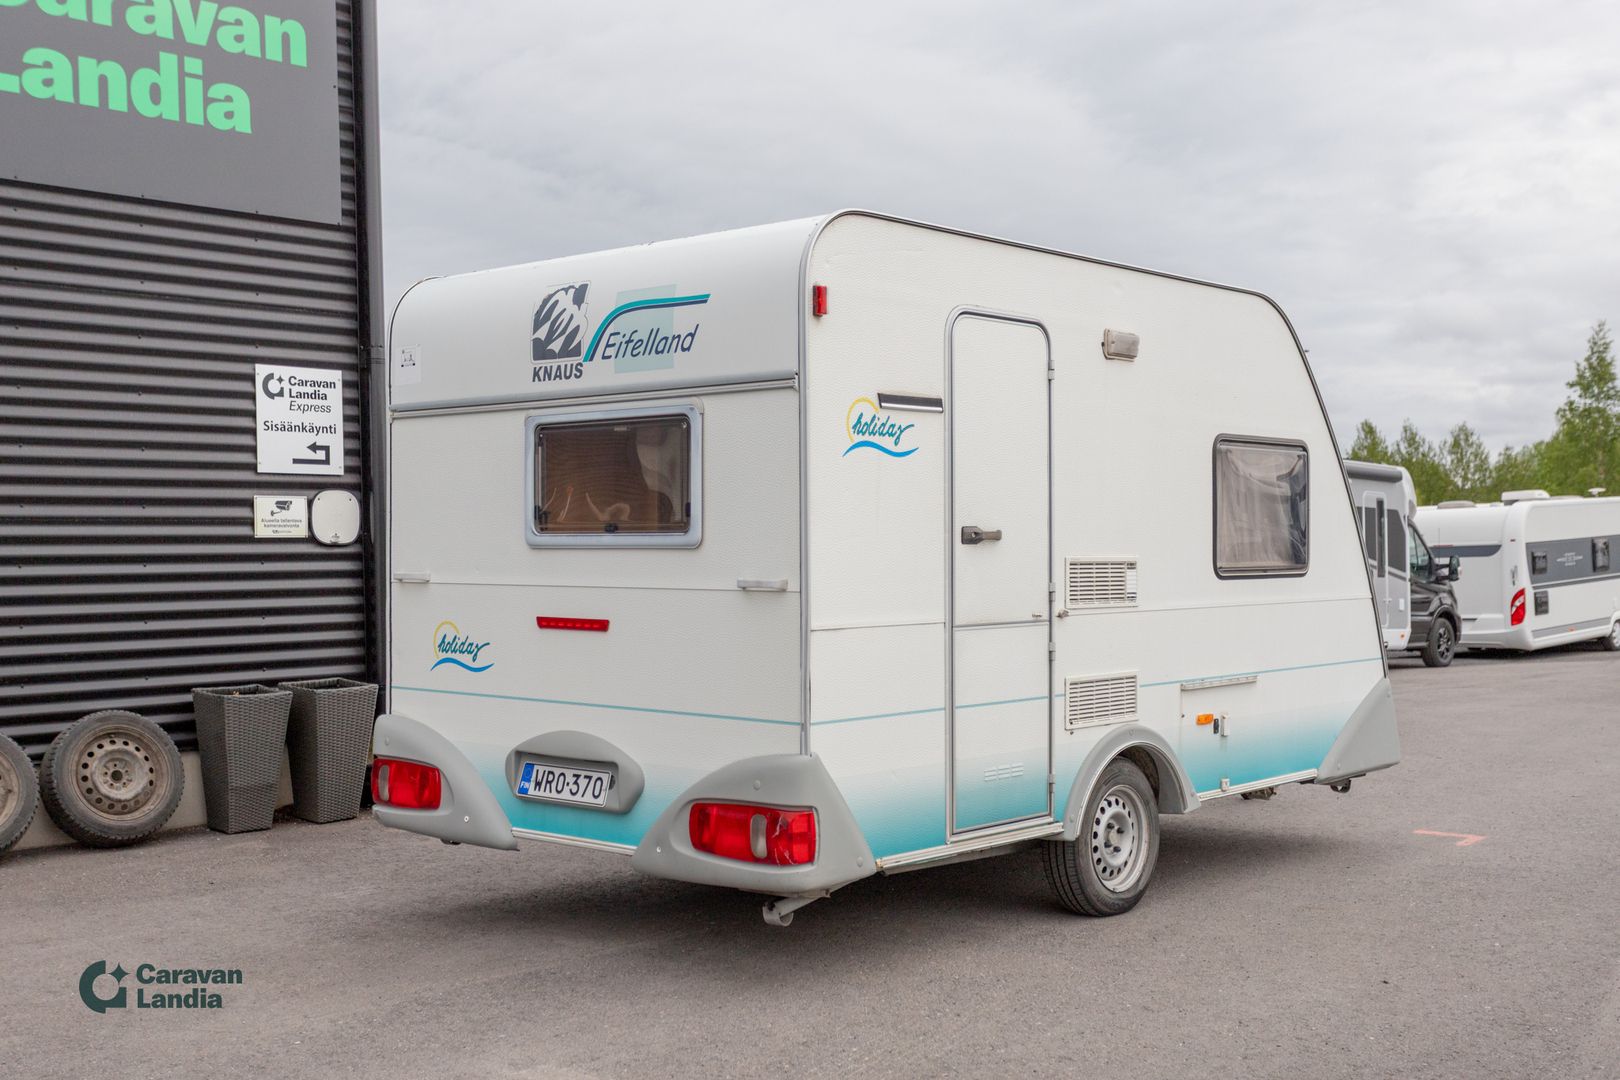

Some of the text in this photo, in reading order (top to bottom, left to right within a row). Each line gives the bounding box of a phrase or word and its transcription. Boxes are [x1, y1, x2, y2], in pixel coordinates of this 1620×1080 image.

[0, 0, 307, 68] avan
[601, 323, 700, 360] Eifelland
[288, 375, 336, 389] Caravan
[532, 362, 584, 382] KNAUS
[288, 388, 328, 401] Landia
[289, 400, 332, 414] Express
[263, 420, 337, 436] Sisäänkäynti
[851, 412, 915, 446] holiday
[437, 633, 490, 663] holiday
[533, 769, 604, 799] WRO-370
